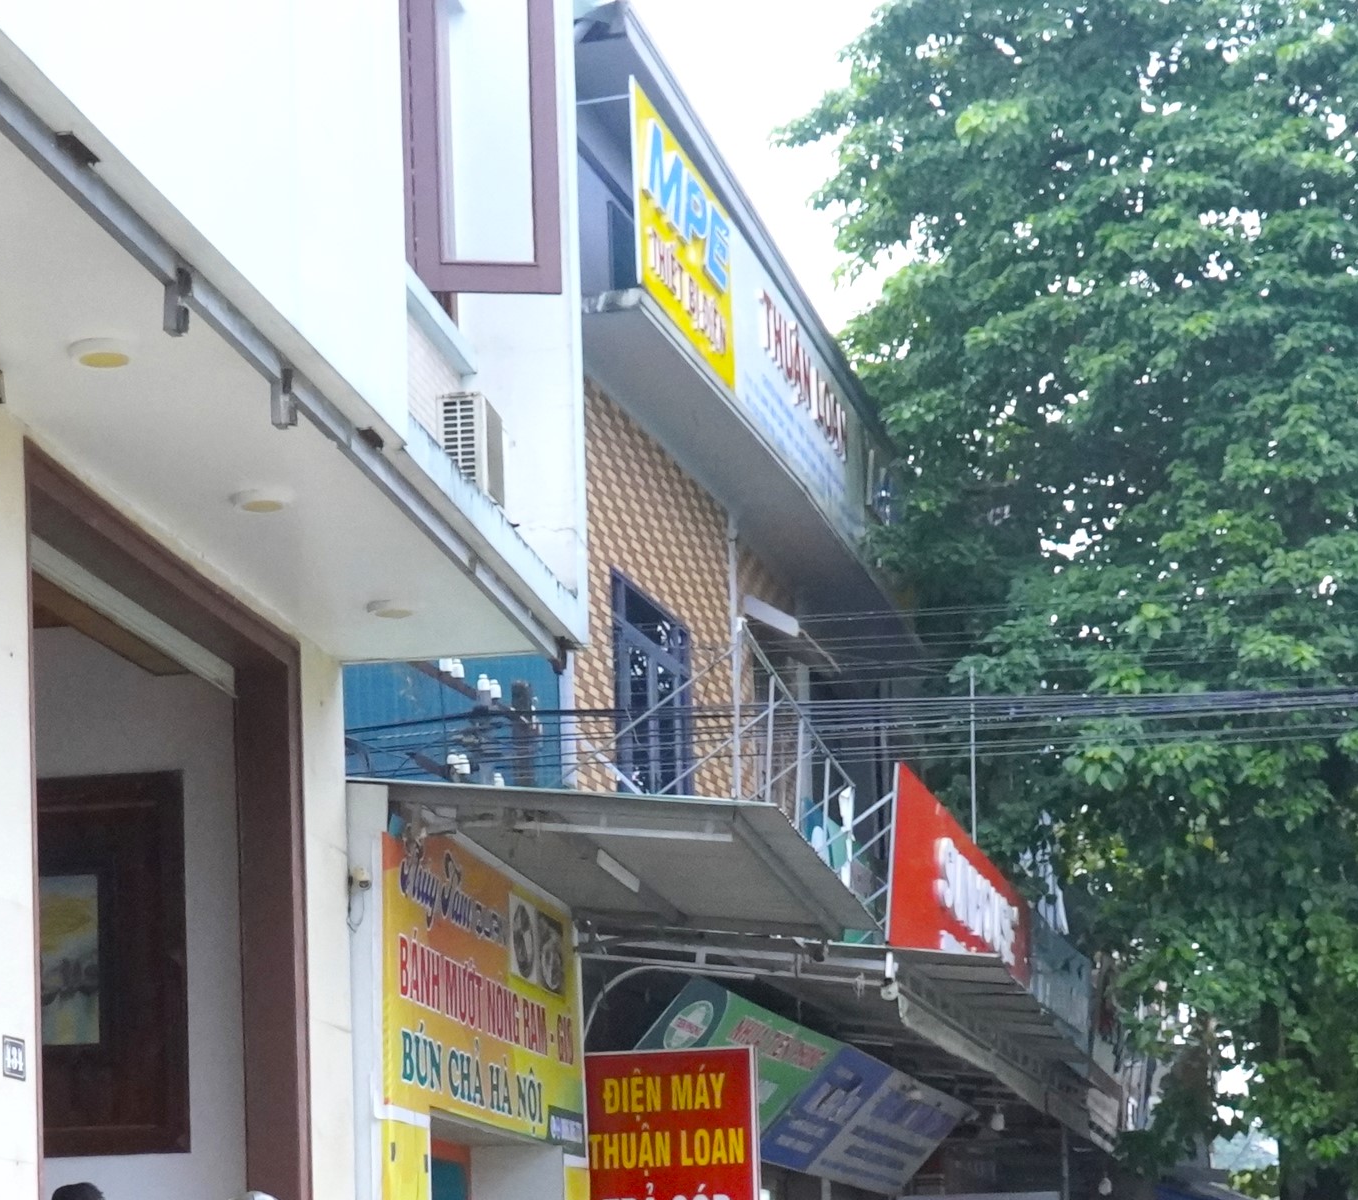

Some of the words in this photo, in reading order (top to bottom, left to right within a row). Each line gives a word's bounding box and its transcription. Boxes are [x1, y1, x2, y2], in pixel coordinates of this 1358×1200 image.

[642, 116, 731, 294] MPE
[399, 928, 441, 1014] BÁNH
[401, 1020, 442, 1094] BÚN
[489, 1054, 513, 1117] HÀ
[516, 1067, 543, 1135] NỘI
[602, 1068, 661, 1122] ĐIỆN
[671, 1064, 725, 1111] MÁY
[589, 1122, 671, 1176] THUẬN
[680, 1127, 744, 1166] LOAN
